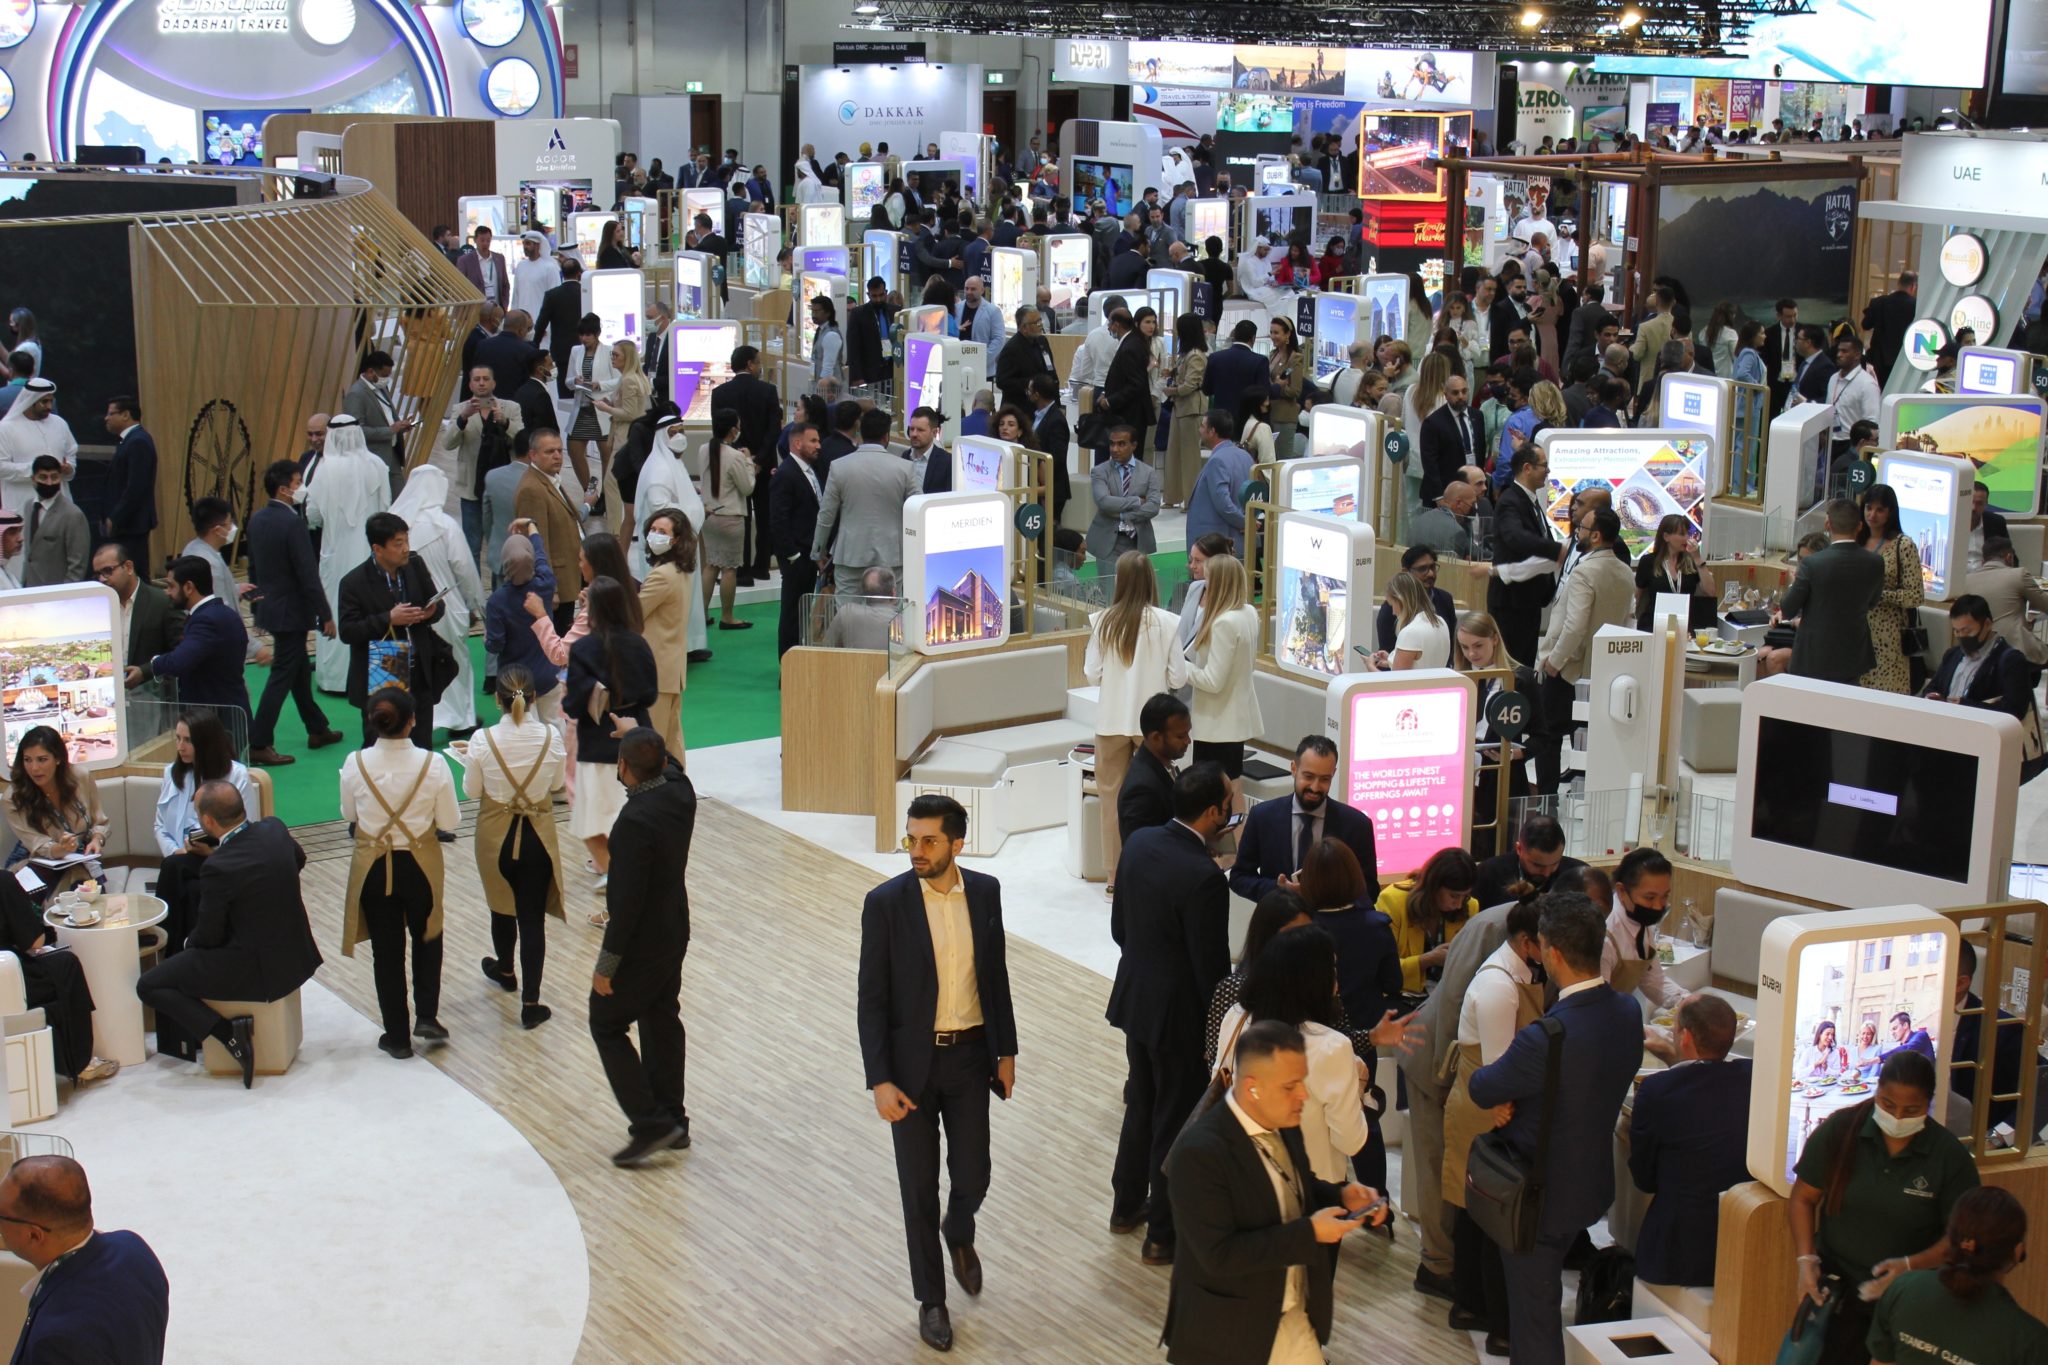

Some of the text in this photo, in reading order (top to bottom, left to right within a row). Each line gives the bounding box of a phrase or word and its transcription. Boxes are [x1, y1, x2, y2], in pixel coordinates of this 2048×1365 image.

[163, 19, 288, 29] DADABHAI TRAVEL
[1315, 100, 1346, 109] Freedom
[864, 106, 924, 118] DAKKAK
[536, 154, 577, 165] ACCOR
[1952, 166, 1982, 182] UAE
[1504, 181, 1526, 197] HATTA
[1825, 194, 1851, 212] HATTA
[1194, 305, 1205, 316] AC9
[1330, 309, 1345, 317] HYDE
[1300, 322, 1312, 333] AC8
[893, 348, 902, 357] 40
[2036, 376, 2048, 387] 50
[1387, 440, 1399, 453] 49
[1555, 447, 1641, 456] Amazing Attractions,
[1852, 469, 1865, 483] 53
[1025, 515, 1041, 531] 45
[1310, 536, 1323, 550] W
[1608, 641, 1643, 654] DUBAI
[1497, 705, 1522, 725] 46
[1354, 766, 1441, 780] THE WORLD'S FINEST
[1353, 776, 1447, 791] SHOPPING & LIFESTYLE
[1353, 787, 1429, 802] OFFERINGS AWAIT
[1762, 974, 1782, 994] DUBAI
[1899, 1331, 1939, 1355] STANDBY
